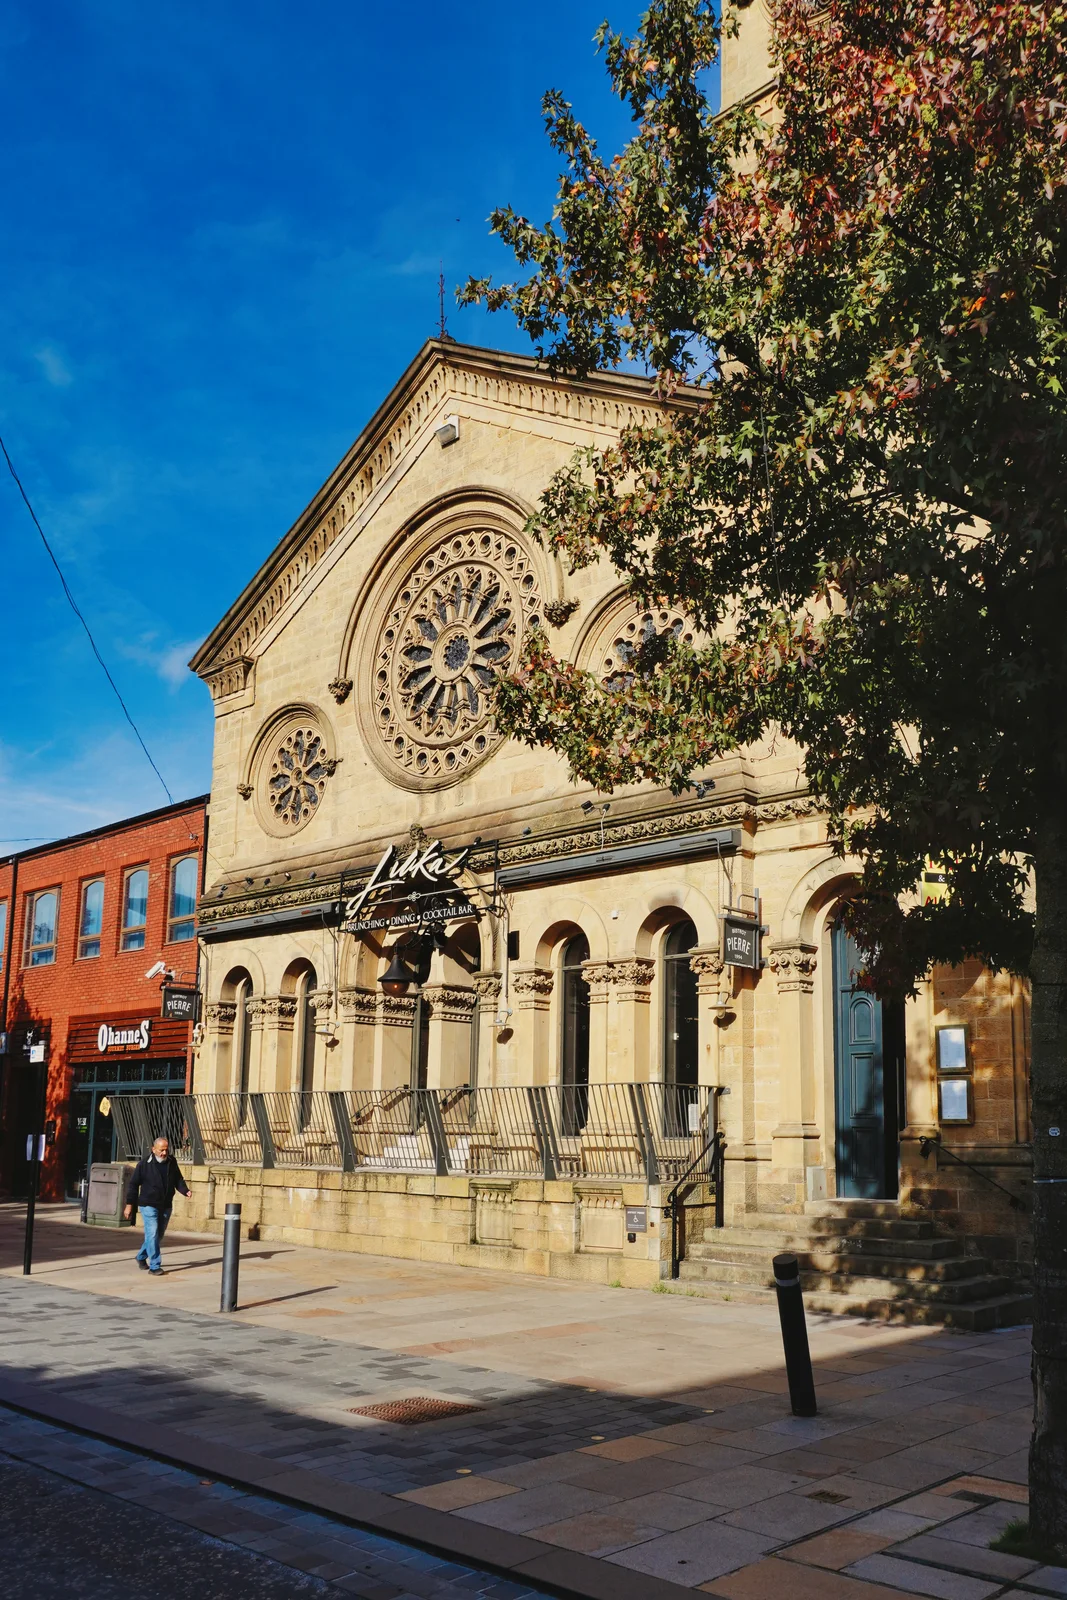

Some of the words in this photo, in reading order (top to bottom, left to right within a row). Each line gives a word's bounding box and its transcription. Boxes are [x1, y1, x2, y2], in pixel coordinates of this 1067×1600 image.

[345, 840, 469, 920] Luka
[347, 918, 385, 932] BRUNCHING
[390, 913, 416, 926] DINING
[422, 907, 457, 920] COCKTAIL
[458, 904, 473, 914] BAR
[726, 937, 751, 955] PIERRE
[166, 1000, 192, 1012] PIERRE
